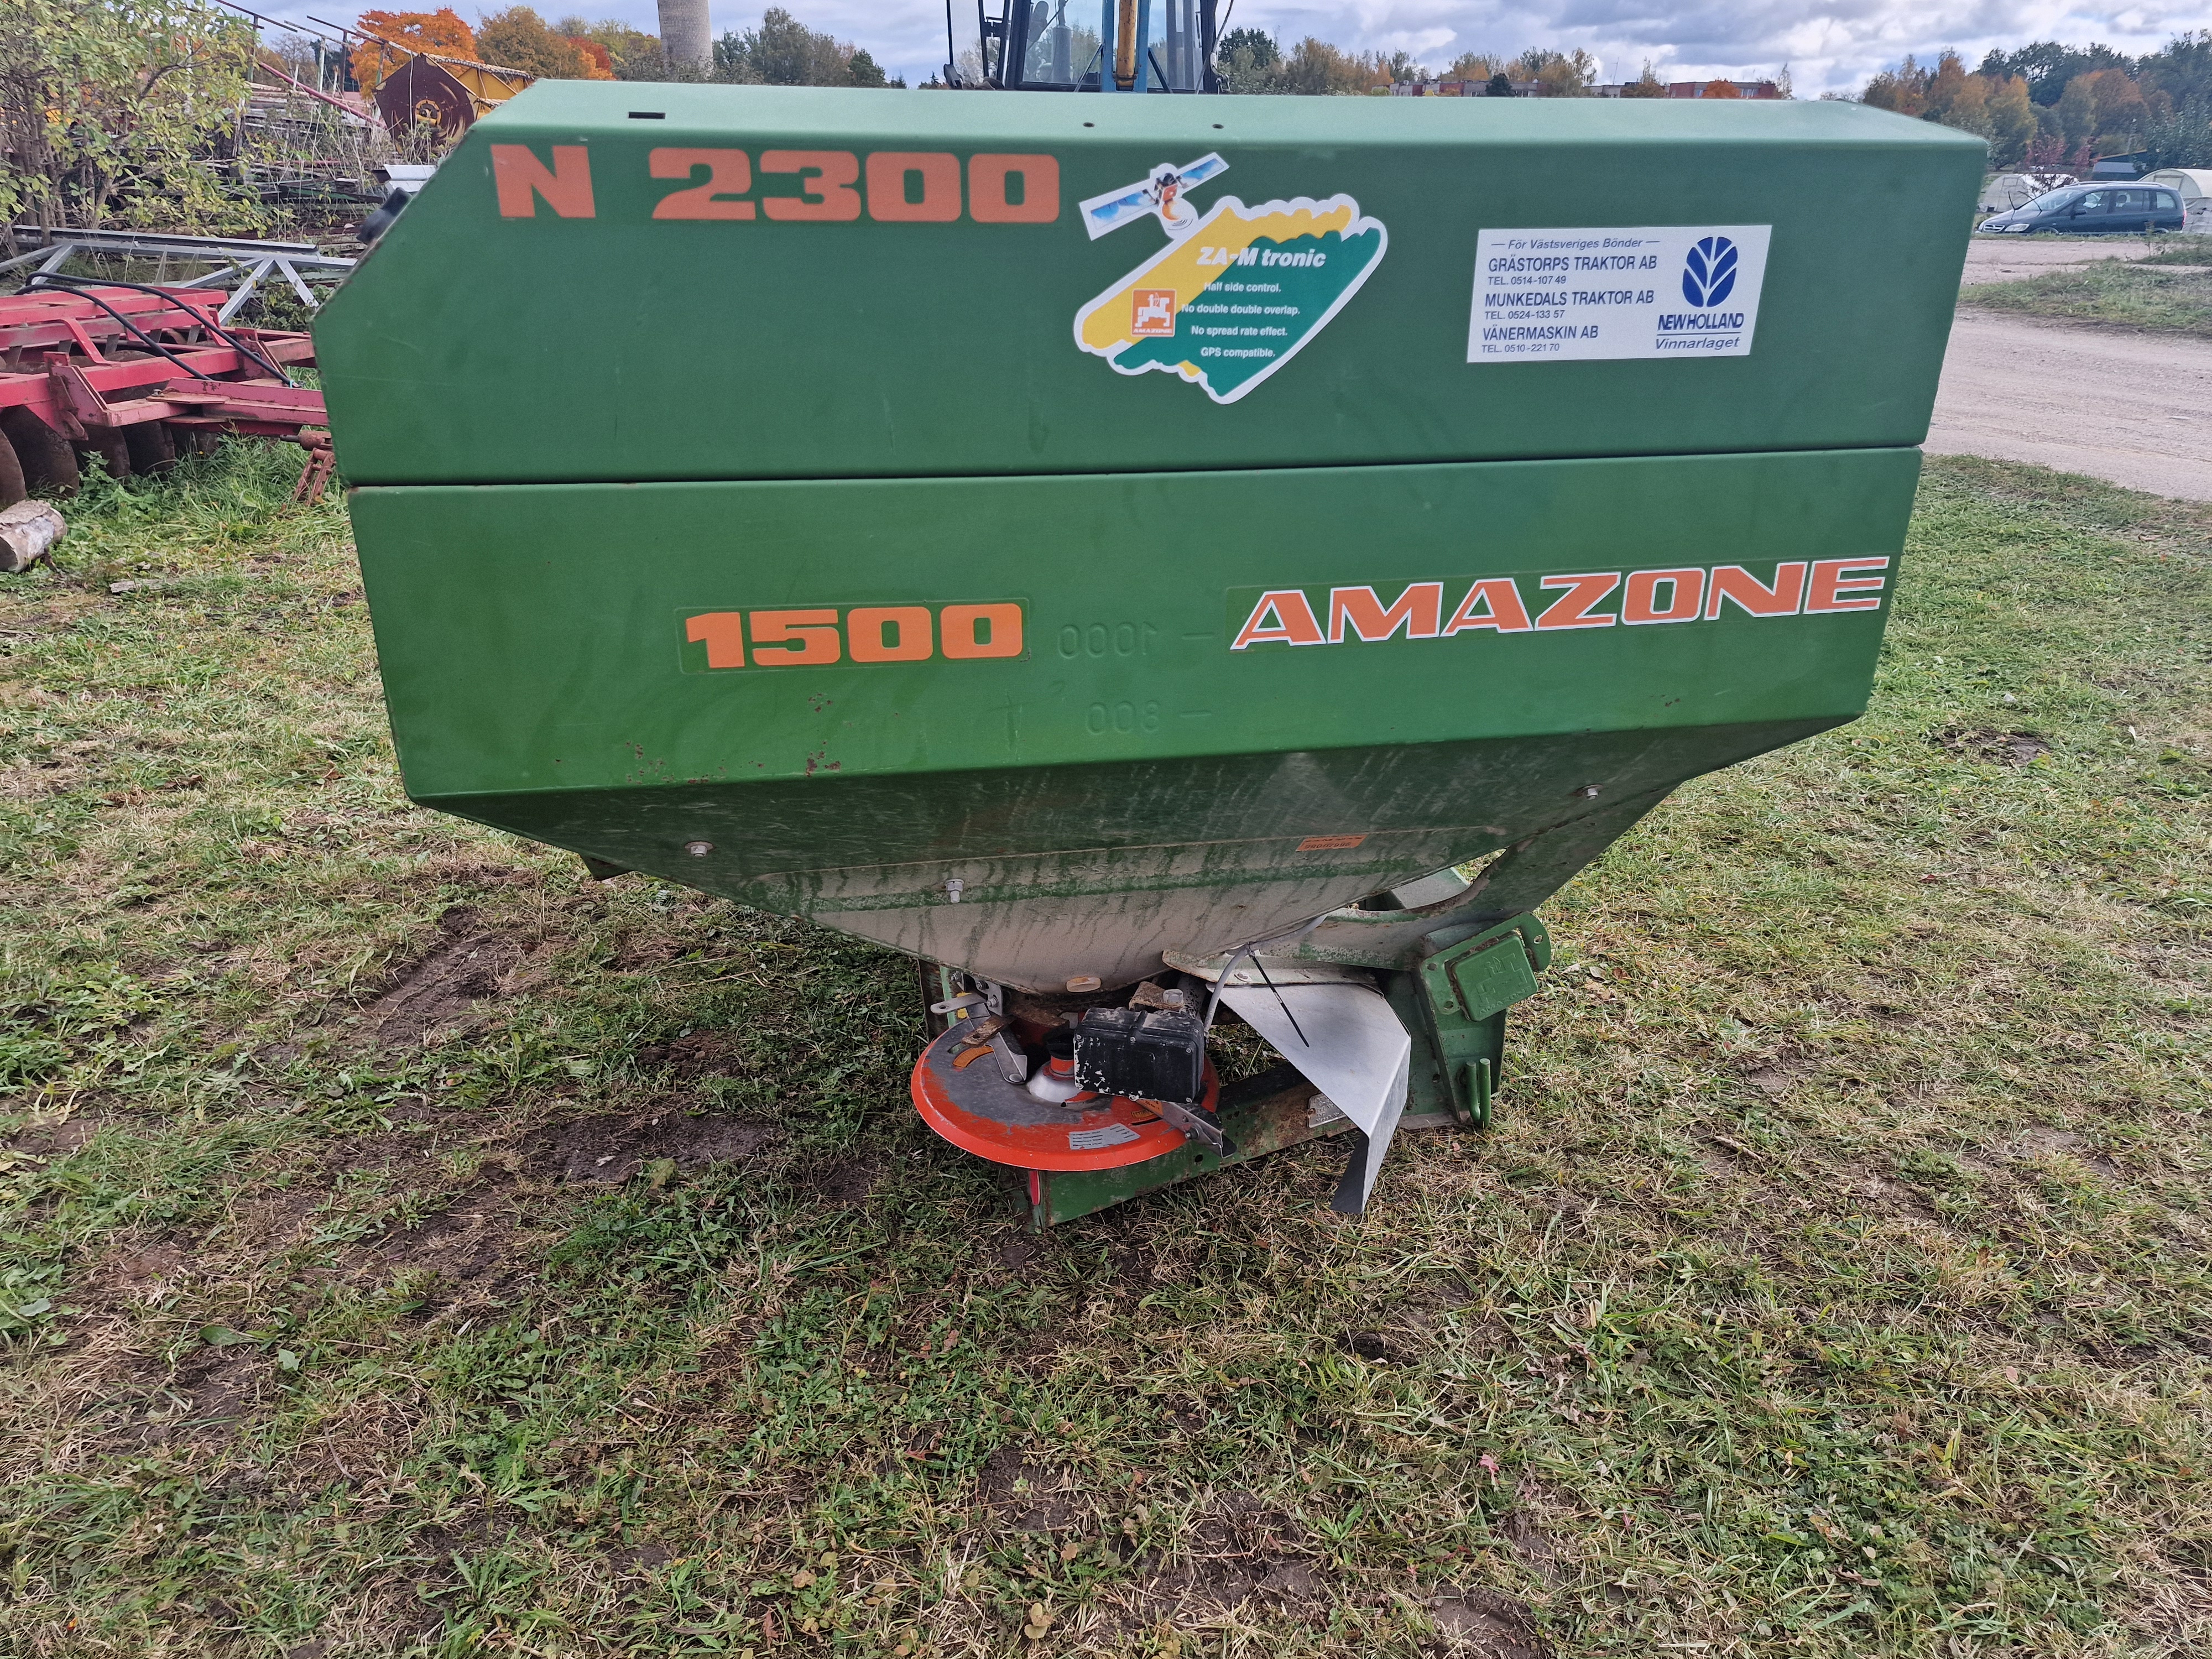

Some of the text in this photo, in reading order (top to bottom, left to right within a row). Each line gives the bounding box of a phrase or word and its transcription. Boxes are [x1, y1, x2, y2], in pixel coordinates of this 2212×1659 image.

[490, 144, 1060, 223] N 2300
[1508, 238, 1643, 251] För Västsveriges Bönder
[1197, 247, 1326, 268] ZA-M tronic
[1489, 254, 1657, 272] GRÄSTORPS TRAKTOR AB
[1204, 282, 1282, 292] Half side control.
[1488, 276, 1509, 285] TEL.
[1485, 290, 1655, 306] MUNKEDALS TRAKTOR AB
[1181, 304, 1300, 317] No double double overlap.
[1485, 310, 1565, 320] TEL. 0524-133 57
[1191, 325, 1288, 337] No spread rate effect.
[1483, 325, 1599, 340] VÄNERMASKIN AB
[1656, 337, 1740, 350] Vinnarlaget
[1201, 347, 1276, 359] GPS compatible.
[1229, 556, 1890, 650] AMAZONE
[685, 603, 1022, 668] 1500
